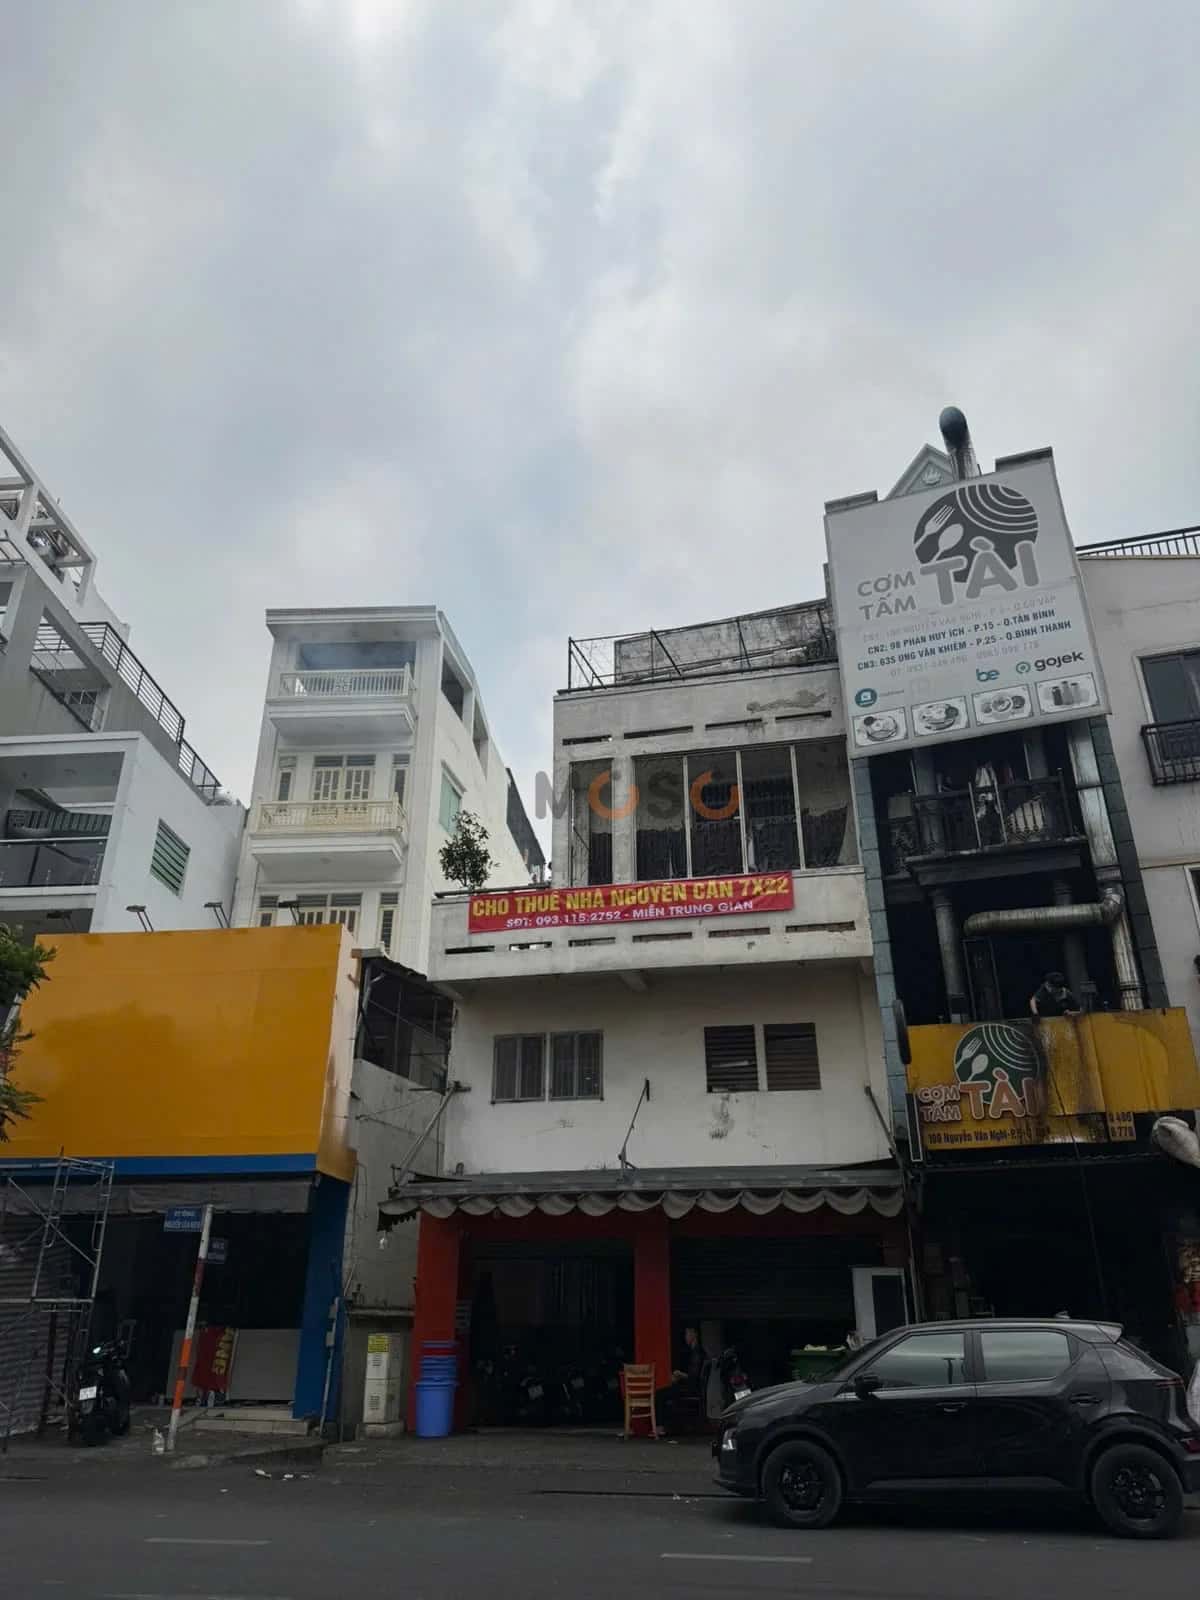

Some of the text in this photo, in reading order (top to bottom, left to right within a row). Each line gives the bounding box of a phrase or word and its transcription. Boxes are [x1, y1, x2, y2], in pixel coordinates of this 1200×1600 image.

[920, 536, 1040, 605] TÀI
[857, 570, 916, 597] CƠM
[858, 592, 917, 620] TẤM
[928, 631, 946, 642] HUY
[974, 621, 994, 632] P.15
[976, 635, 996, 646] P.25
[1034, 651, 1084, 672] gojek
[976, 668, 1000, 682] be
[472, 898, 509, 917] CHO
[669, 903, 714, 916] TRUNG
[718, 900, 753, 913] GIAN
[920, 1086, 960, 1102] CƠM
[921, 1101, 961, 1121] TẤM
